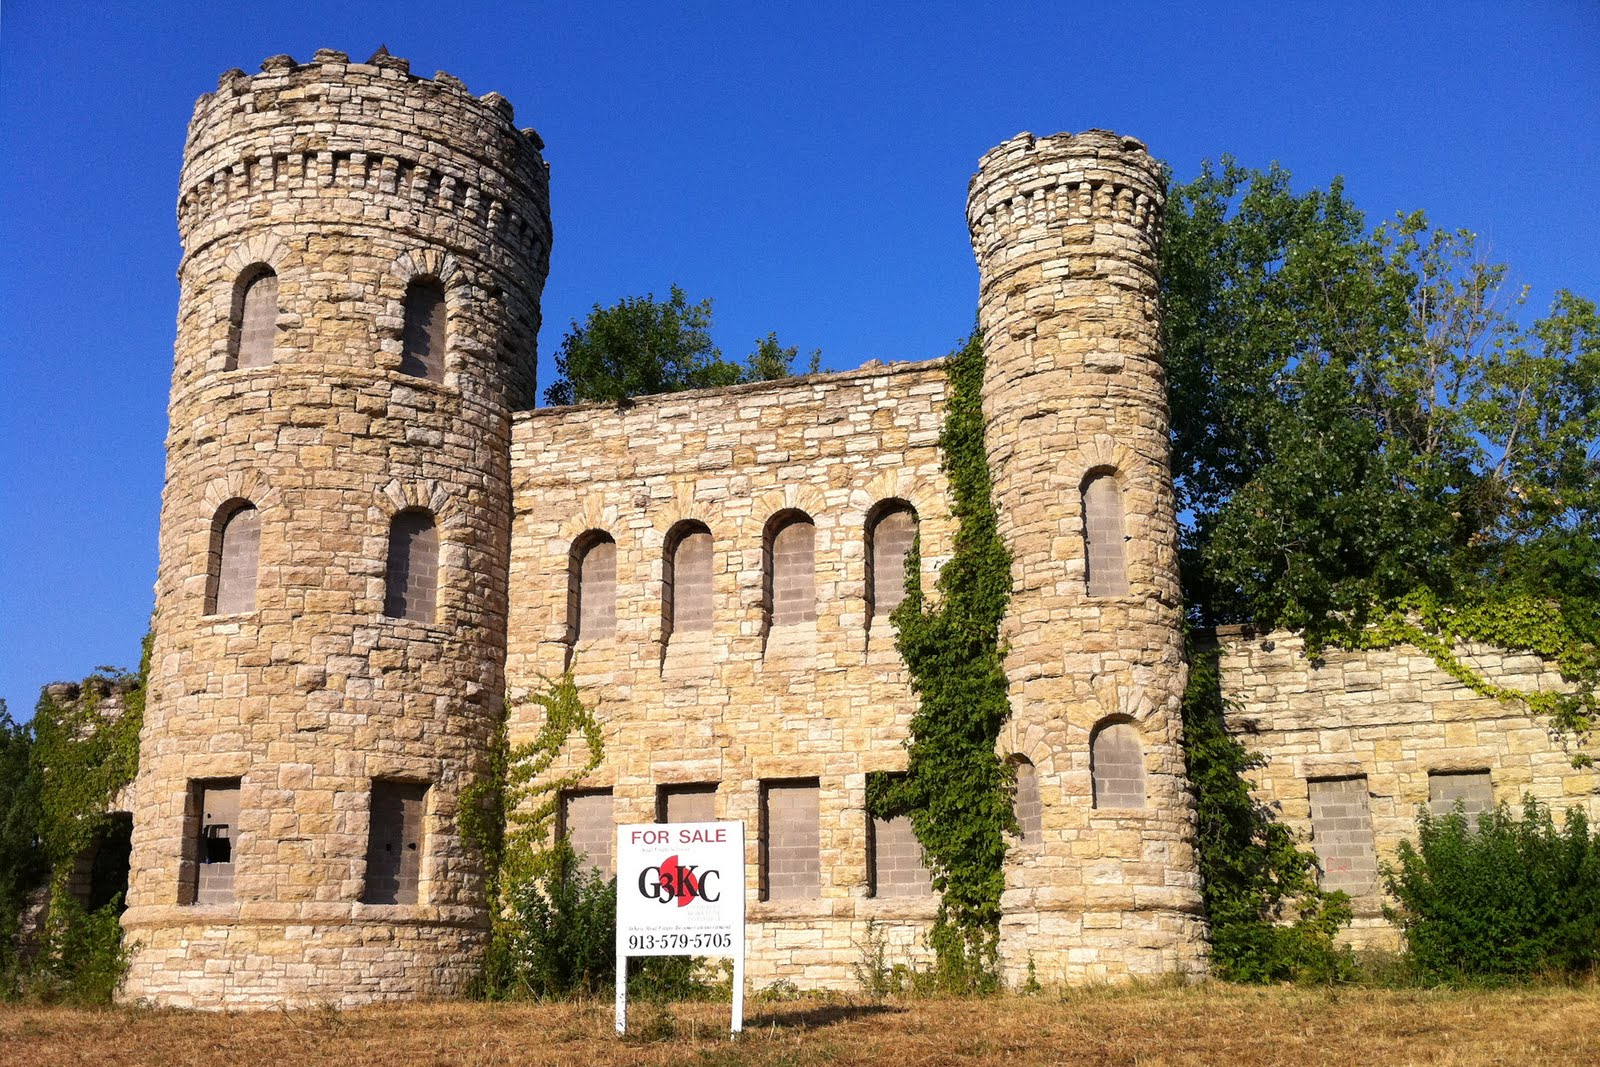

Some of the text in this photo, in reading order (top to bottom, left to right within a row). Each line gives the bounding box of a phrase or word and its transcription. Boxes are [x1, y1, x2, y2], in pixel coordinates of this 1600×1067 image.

[631, 828, 727, 845] FOR SALE
[638, 865, 721, 904] G3KC
[628, 933, 732, 950] 913-579-5705
